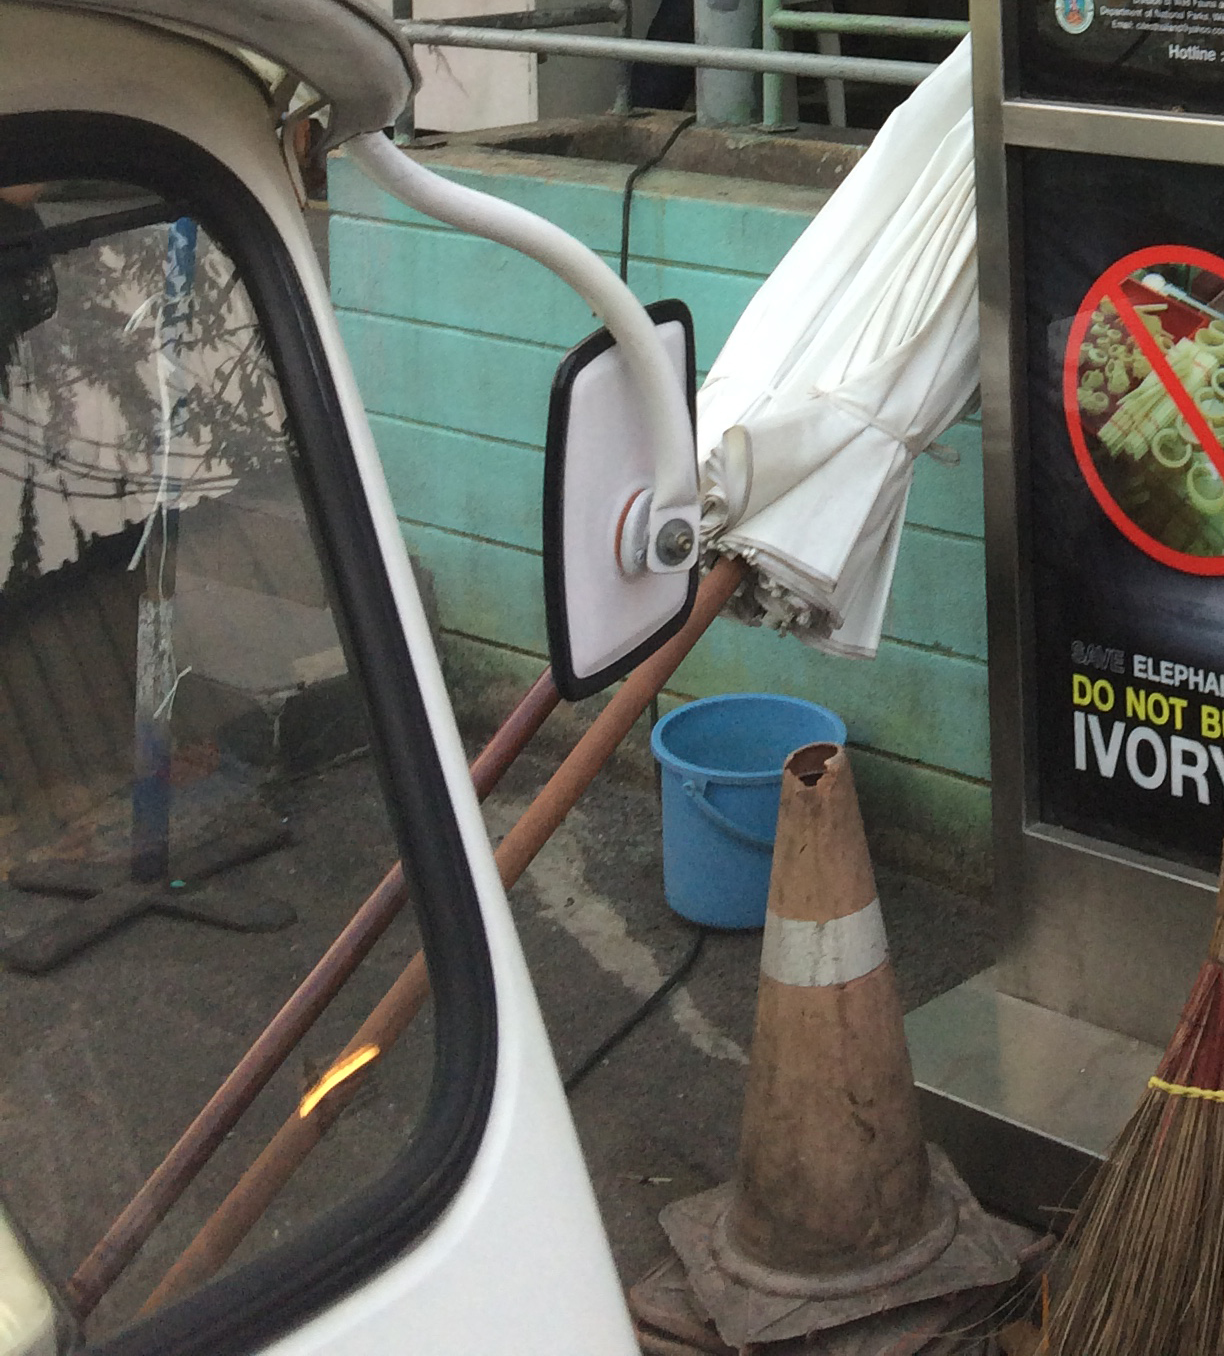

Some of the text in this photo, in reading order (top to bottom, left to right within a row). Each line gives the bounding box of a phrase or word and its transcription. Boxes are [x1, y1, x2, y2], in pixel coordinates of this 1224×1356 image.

[1168, 44, 1217, 63] Hotline
[1071, 640, 1125, 674] SAVE
[1072, 673, 1115, 712] DO
[1126, 686, 1188, 730] NOT
